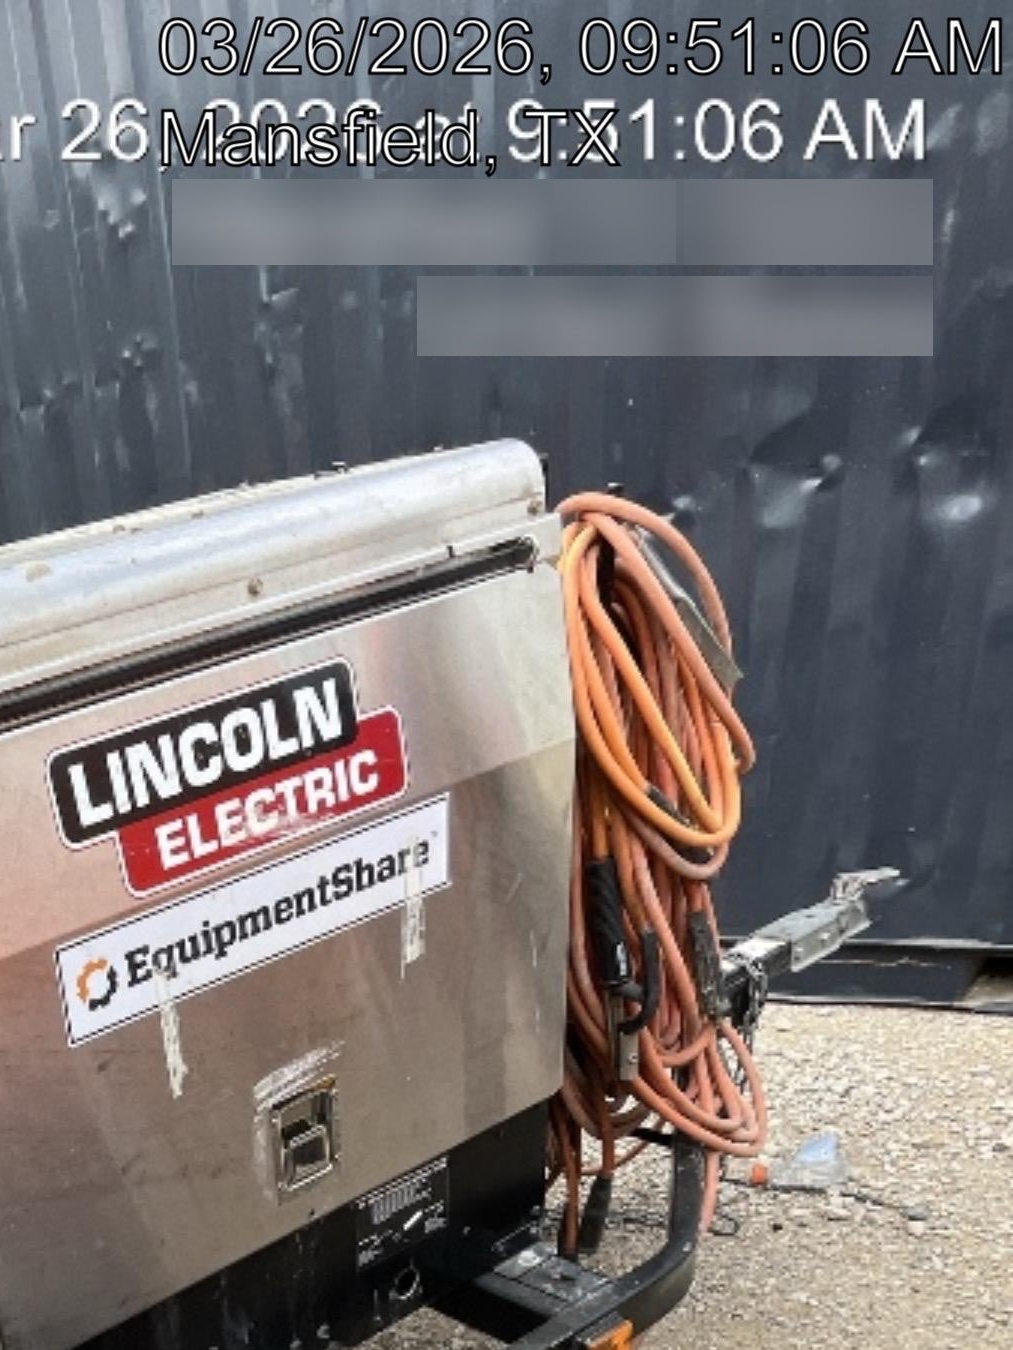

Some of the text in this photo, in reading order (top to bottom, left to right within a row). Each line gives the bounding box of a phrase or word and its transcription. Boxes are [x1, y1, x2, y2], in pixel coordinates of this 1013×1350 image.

[68, 676, 343, 830] LINCOLN
[155, 747, 380, 871] ELECTRIC
[124, 837, 431, 989] EquipmentShare
